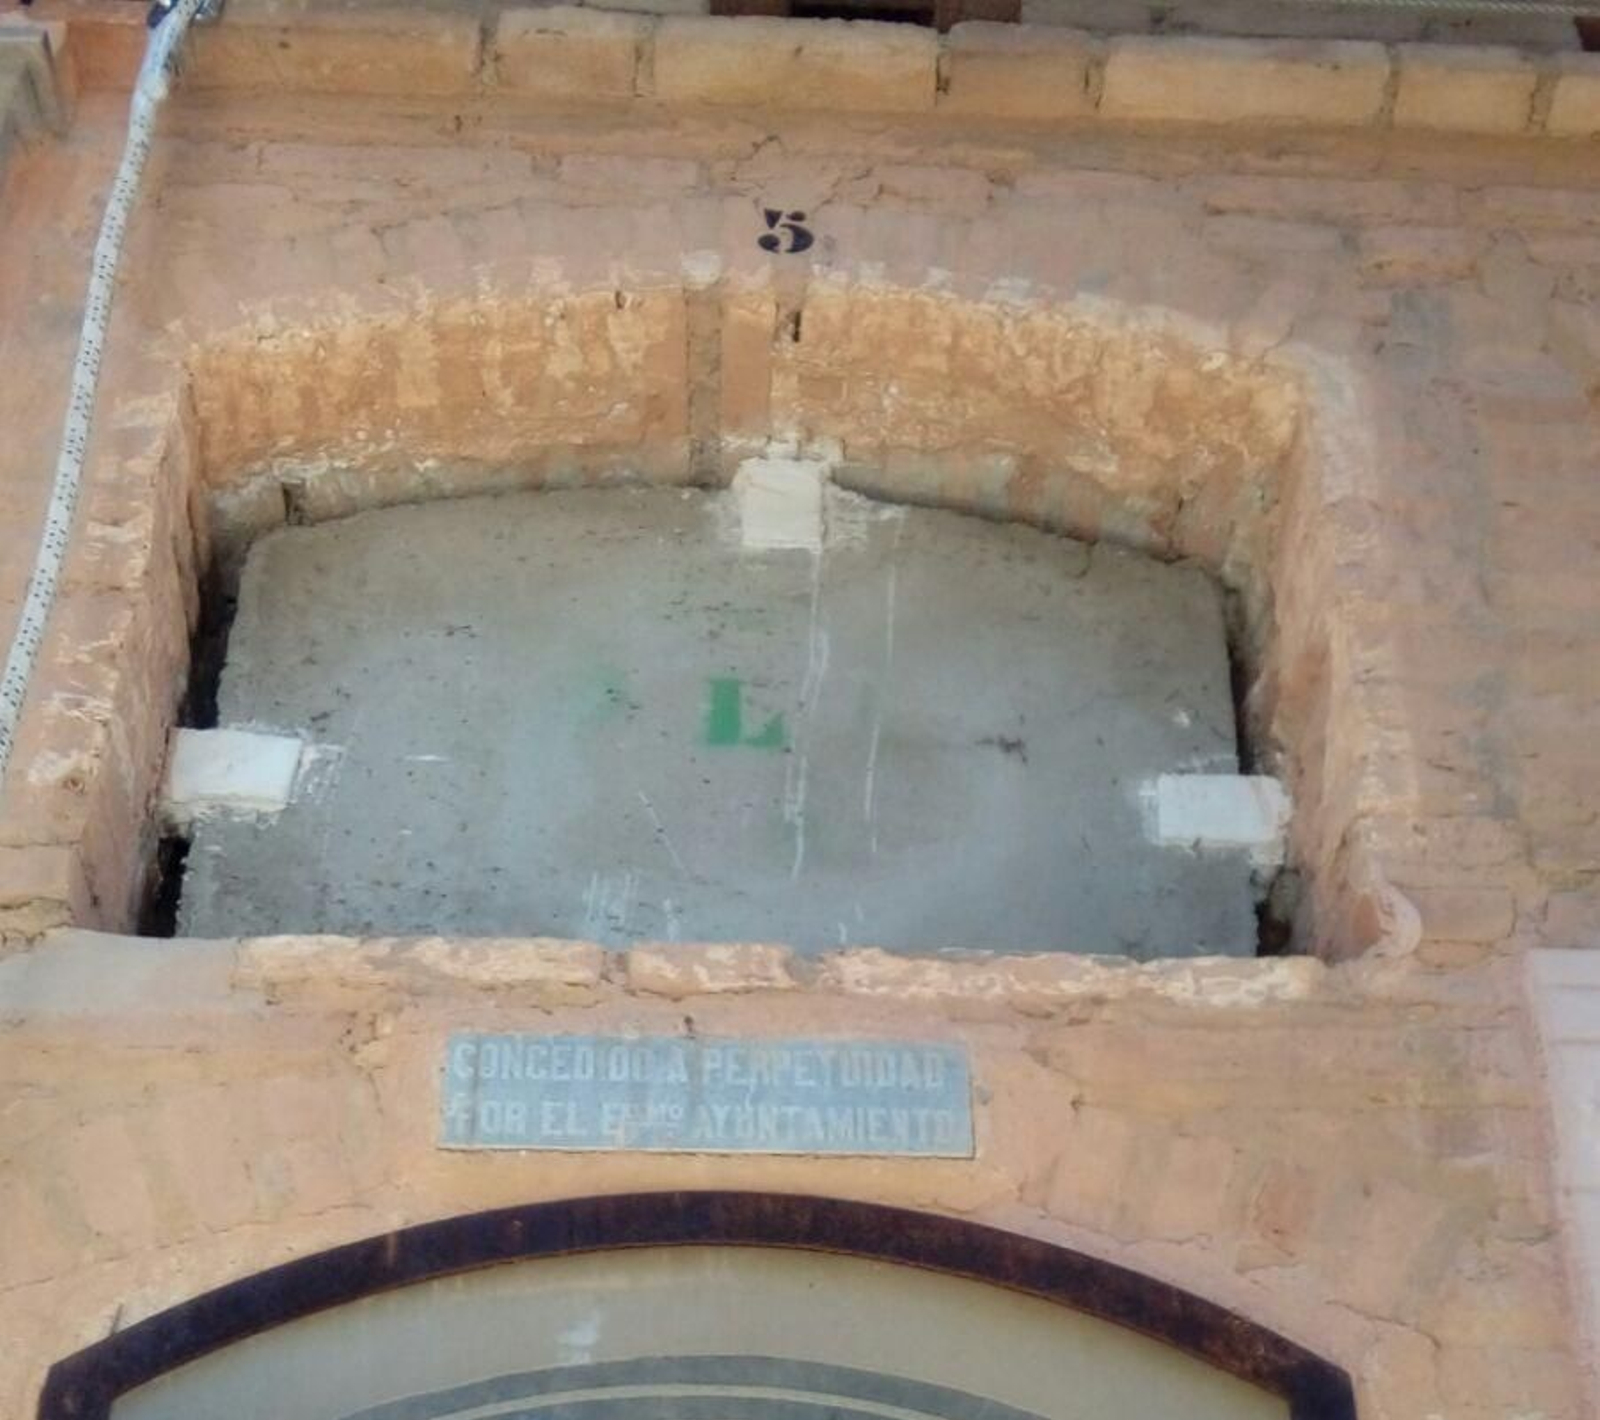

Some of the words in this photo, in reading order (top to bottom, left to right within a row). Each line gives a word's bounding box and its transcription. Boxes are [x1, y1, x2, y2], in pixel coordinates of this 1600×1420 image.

[757, 207, 815, 255] 5
[664, 1044, 690, 1083] A
[540, 1100, 588, 1137] EL
[695, 1102, 953, 1146] AYUNTAMIENTO
